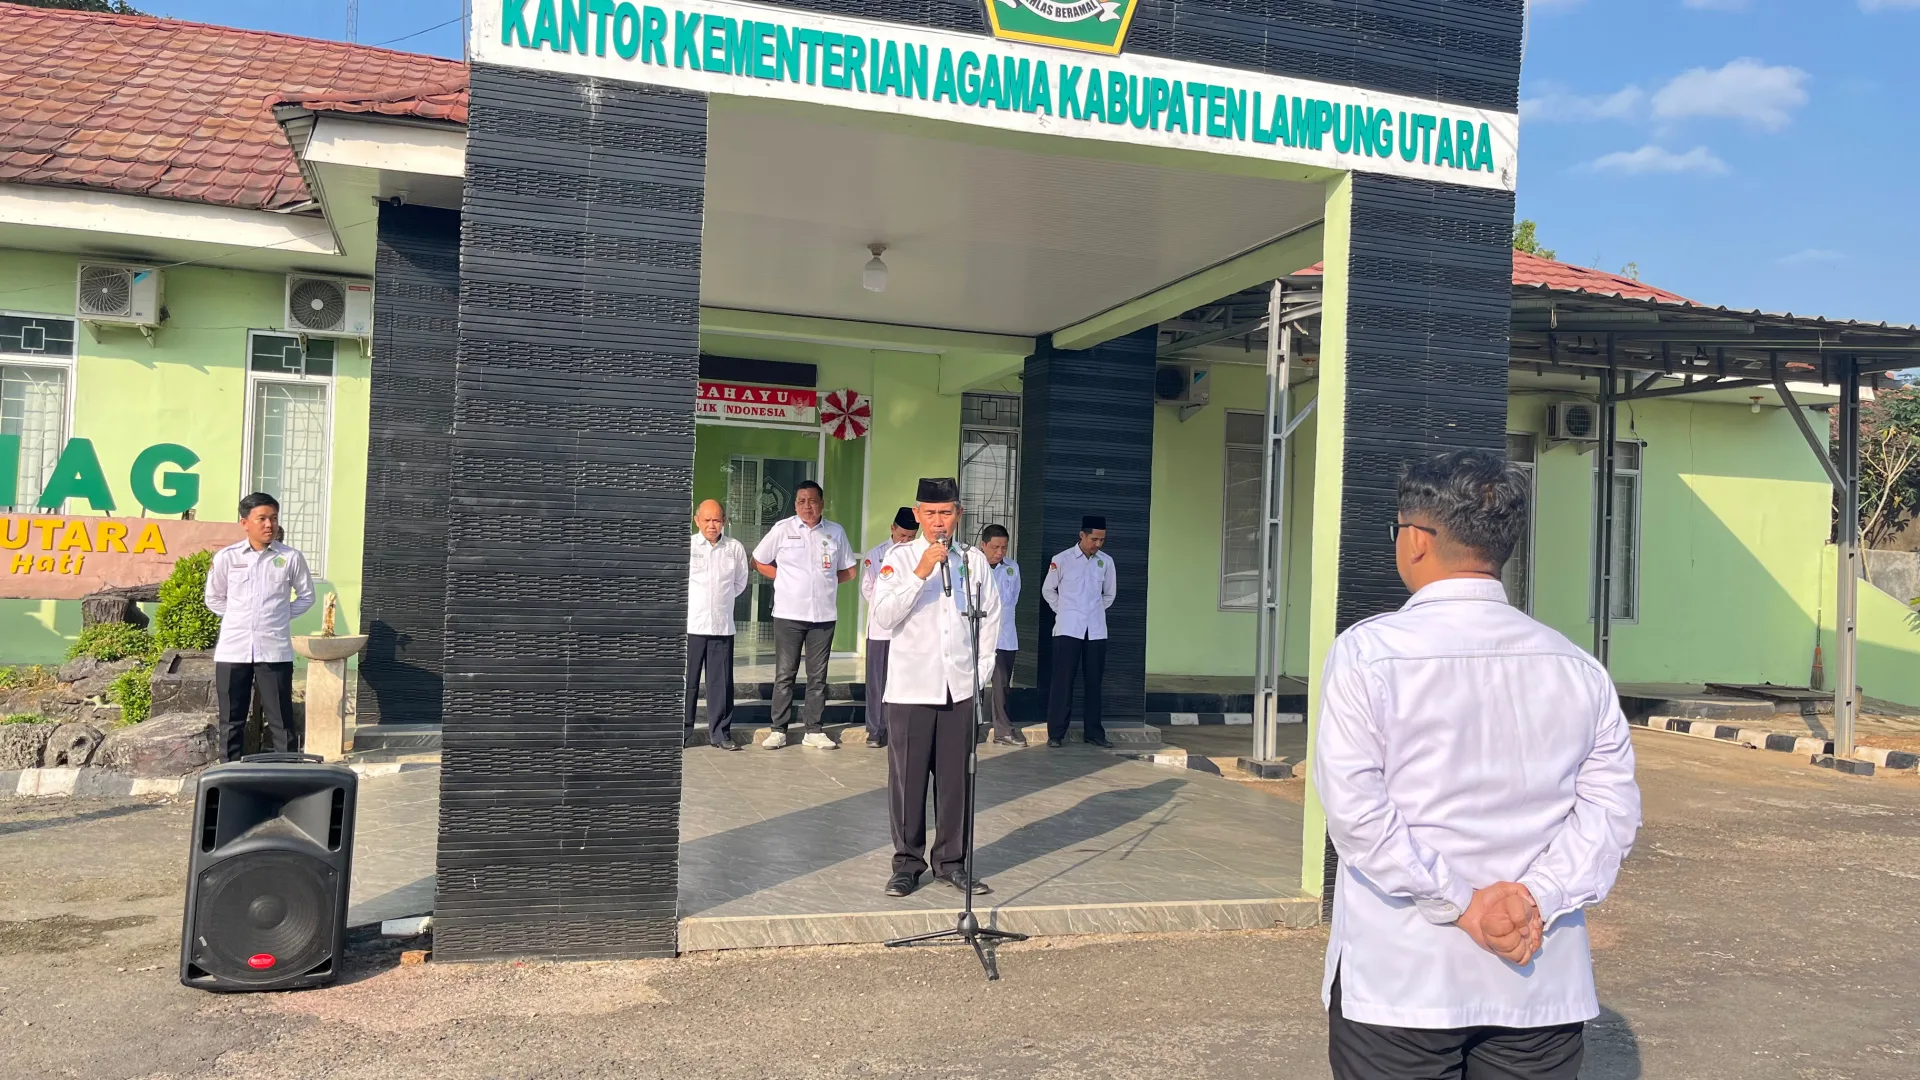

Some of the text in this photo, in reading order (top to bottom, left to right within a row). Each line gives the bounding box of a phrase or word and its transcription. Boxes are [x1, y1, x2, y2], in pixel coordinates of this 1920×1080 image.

[1055, 0, 1098, 18] BERAMAL
[501, 0, 1494, 172] KANTOR KEMENTERIAN AGAMA KABUPATEN LAMPUNG UTARA
[0, 517, 168, 555] UTARA
